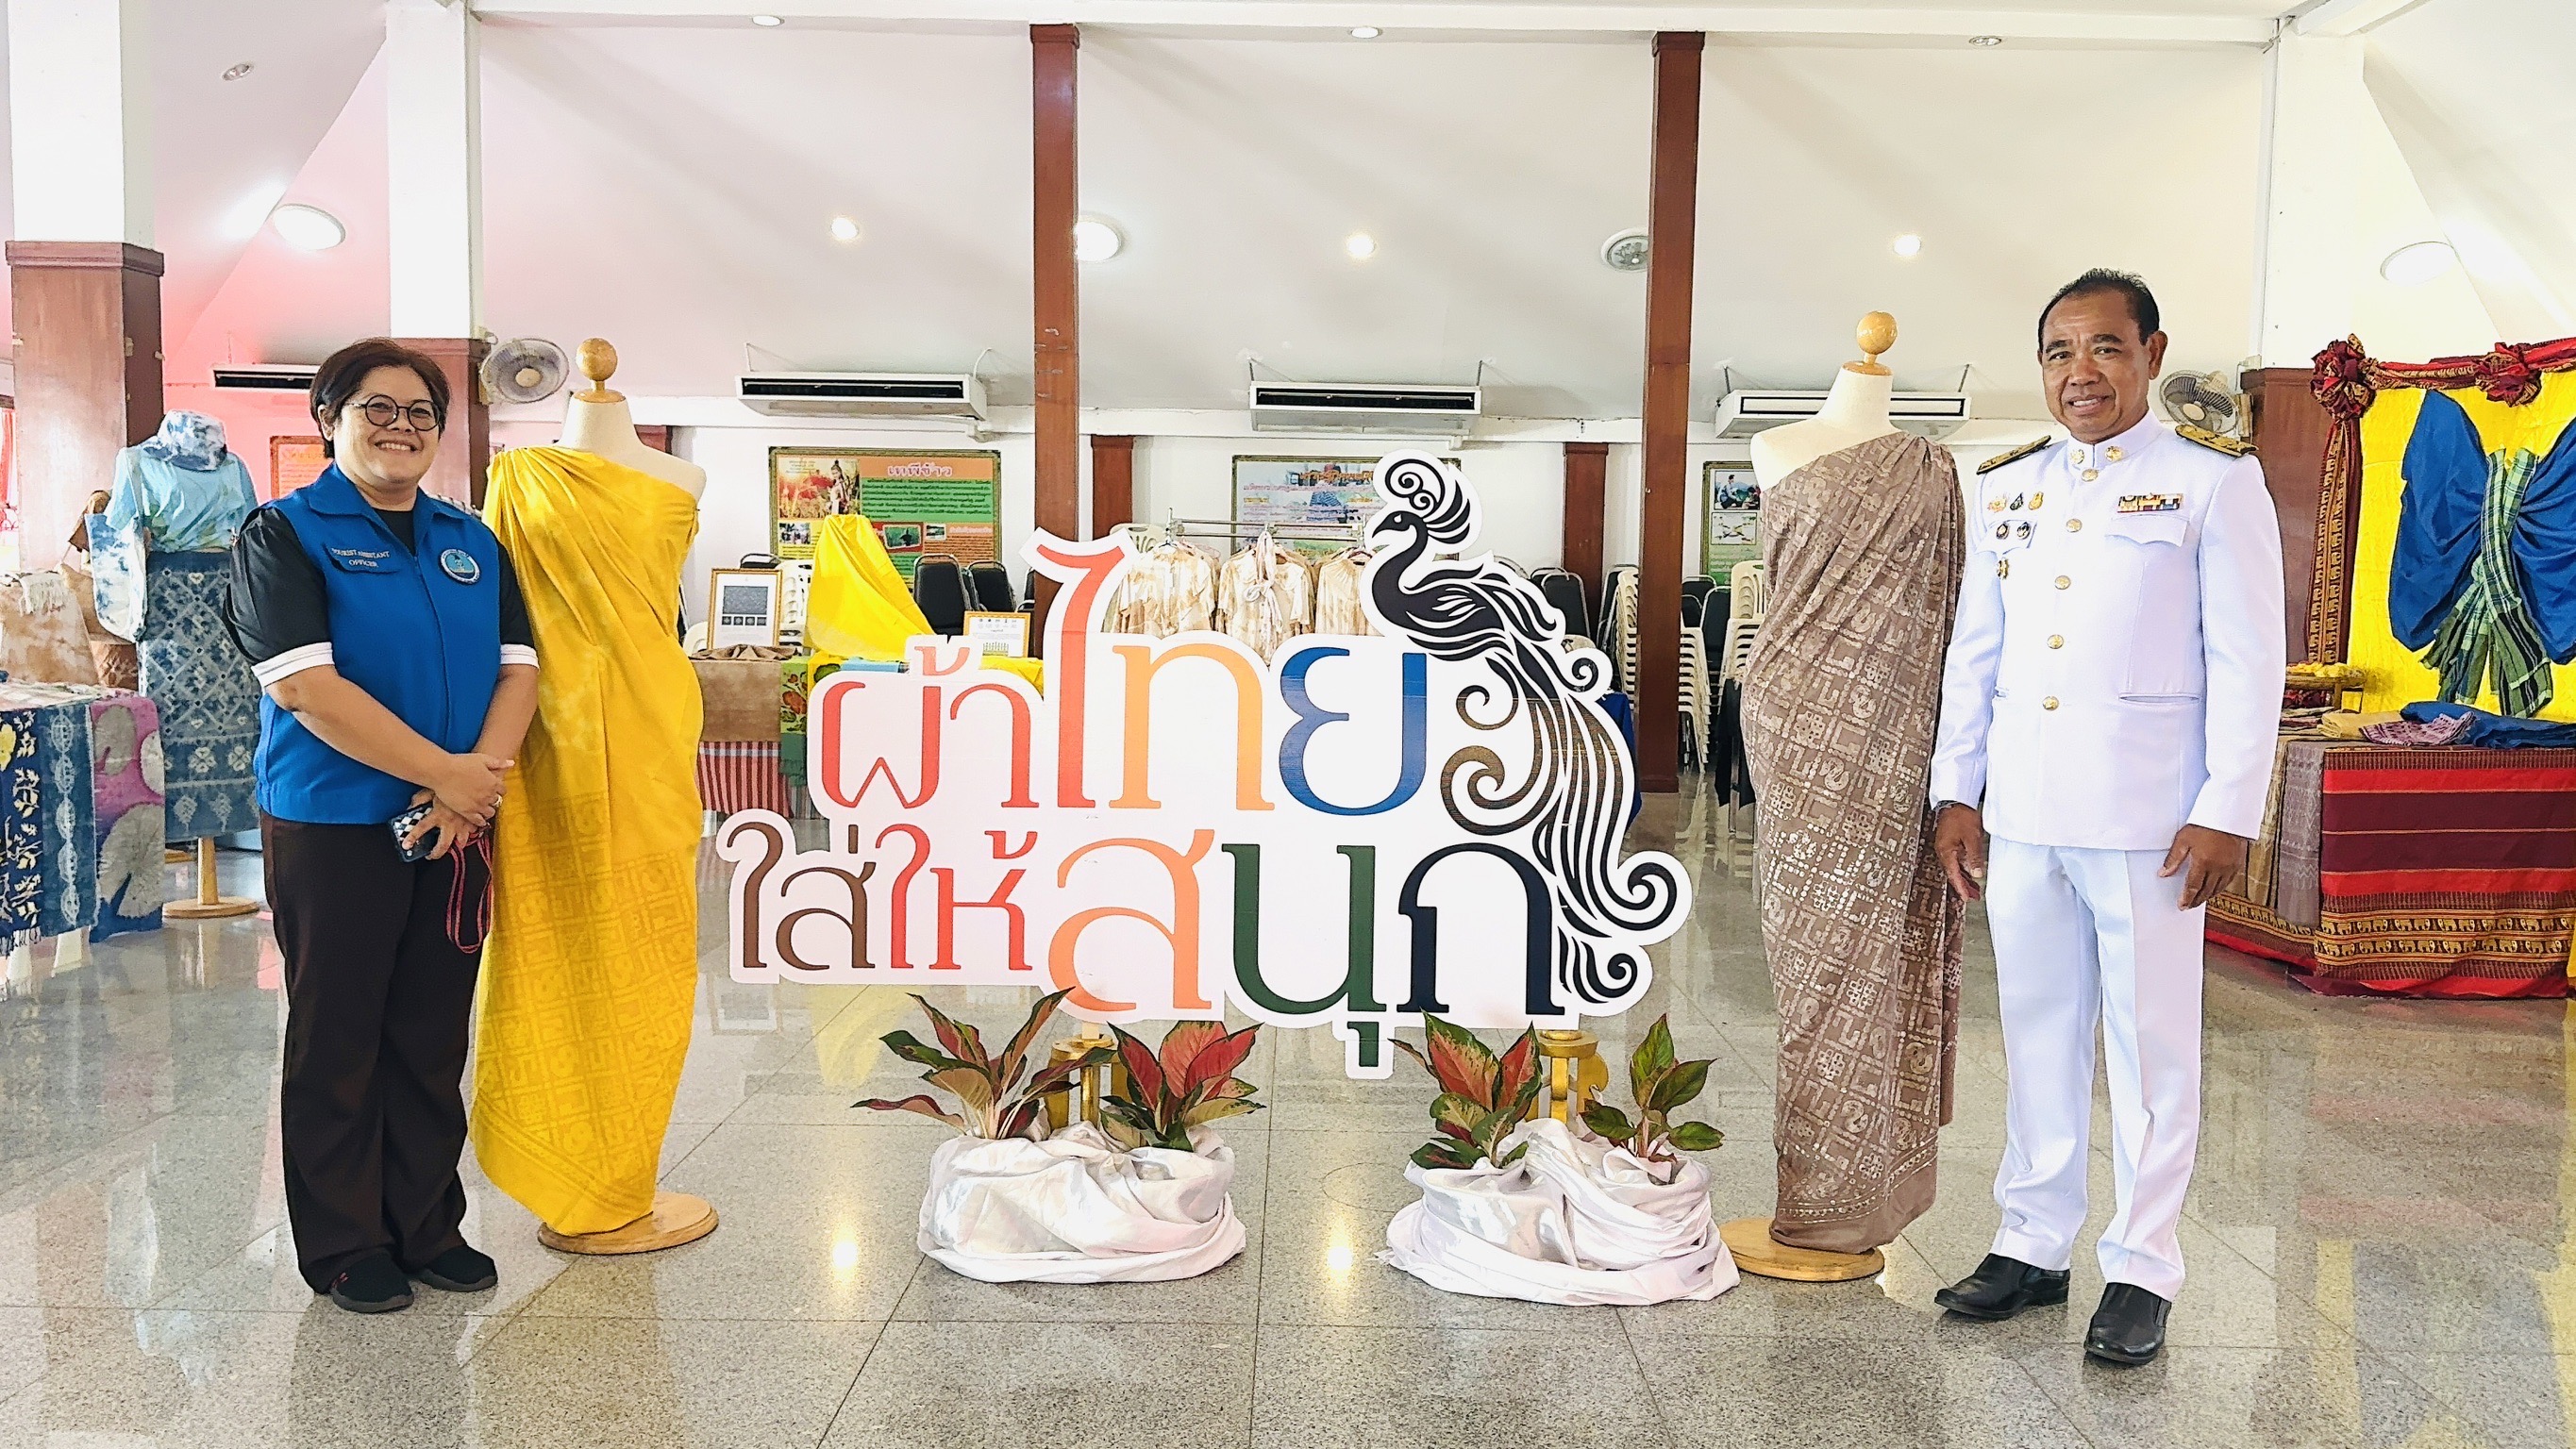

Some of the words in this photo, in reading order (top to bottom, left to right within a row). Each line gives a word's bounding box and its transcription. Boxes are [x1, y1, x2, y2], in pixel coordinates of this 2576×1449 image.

[822, 543, 1428, 815] ผ้าไทย
[727, 822, 1564, 1068] ใส่ให้สนุก
